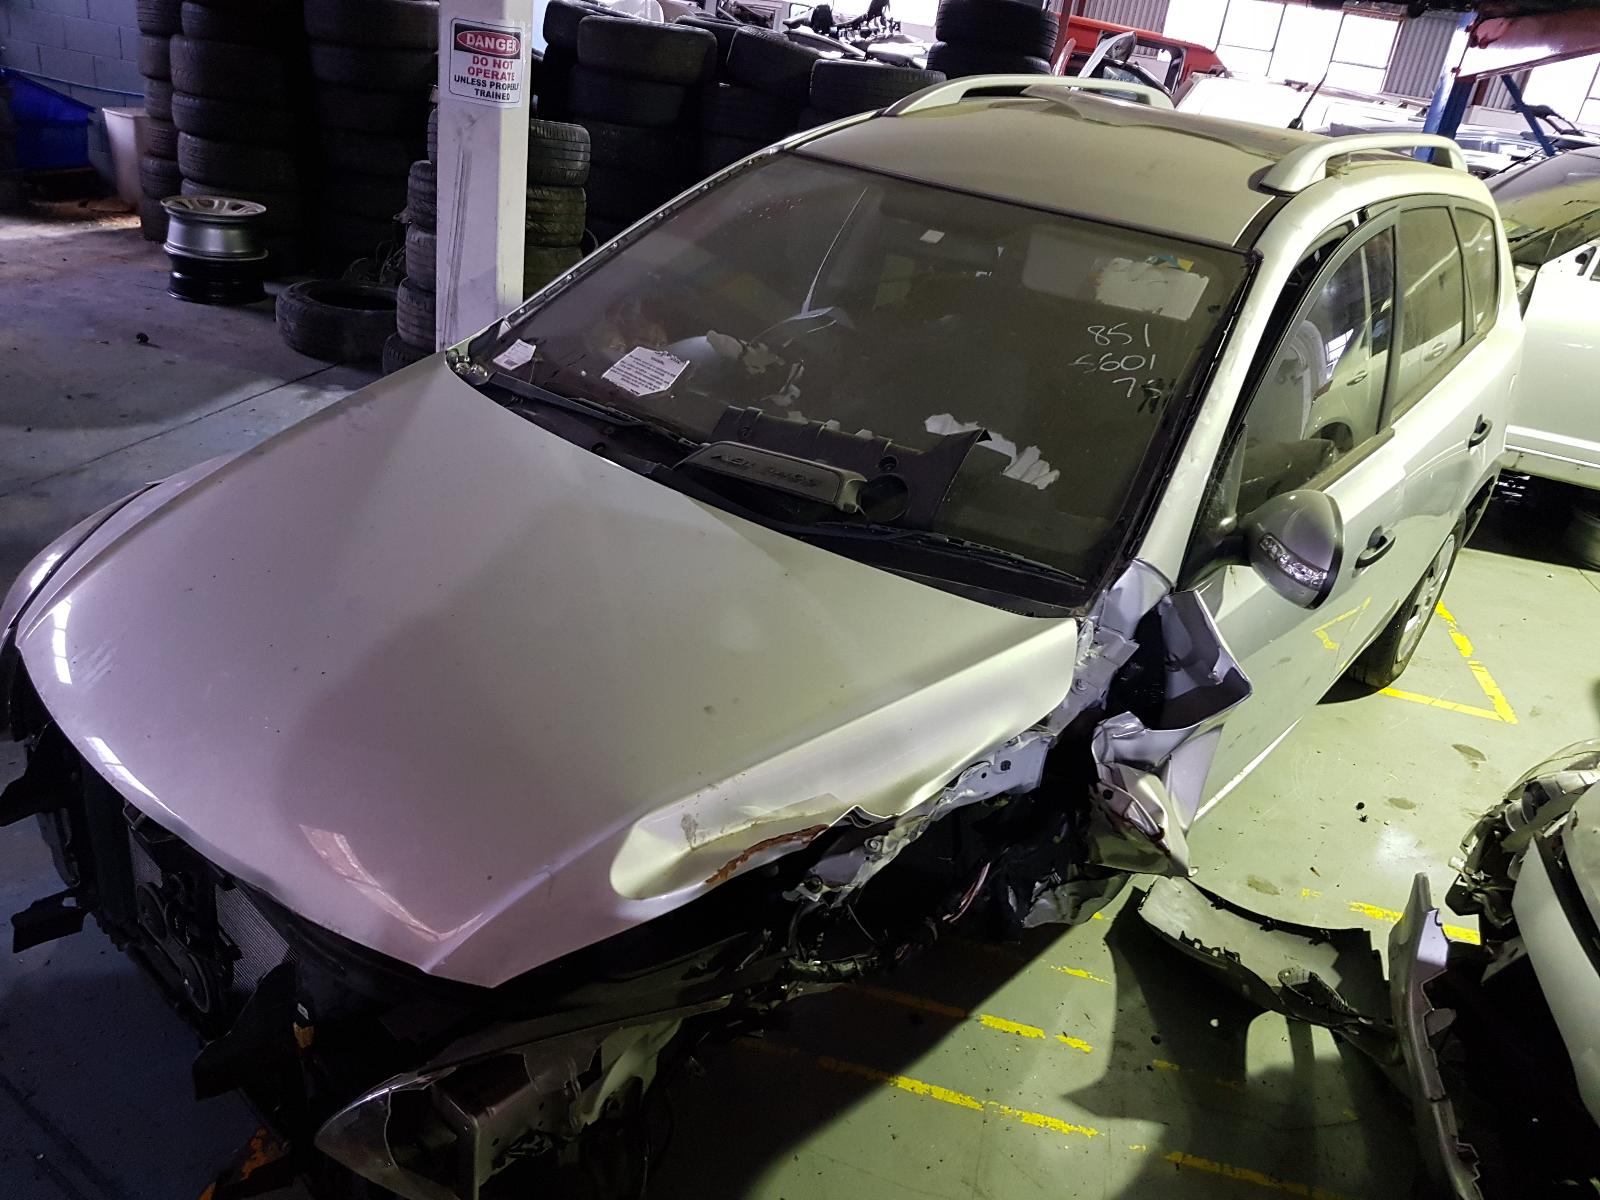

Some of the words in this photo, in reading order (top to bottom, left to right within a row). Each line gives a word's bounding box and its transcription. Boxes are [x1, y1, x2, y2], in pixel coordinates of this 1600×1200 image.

[466, 33, 517, 52] DANGER
[472, 55, 489, 67] DO
[493, 60, 514, 70] NOT
[454, 74, 487, 88] UNLESS
[467, 66, 515, 81] OPERATE
[474, 88, 511, 101] TRAINED
[1087, 322, 1151, 348] 851
